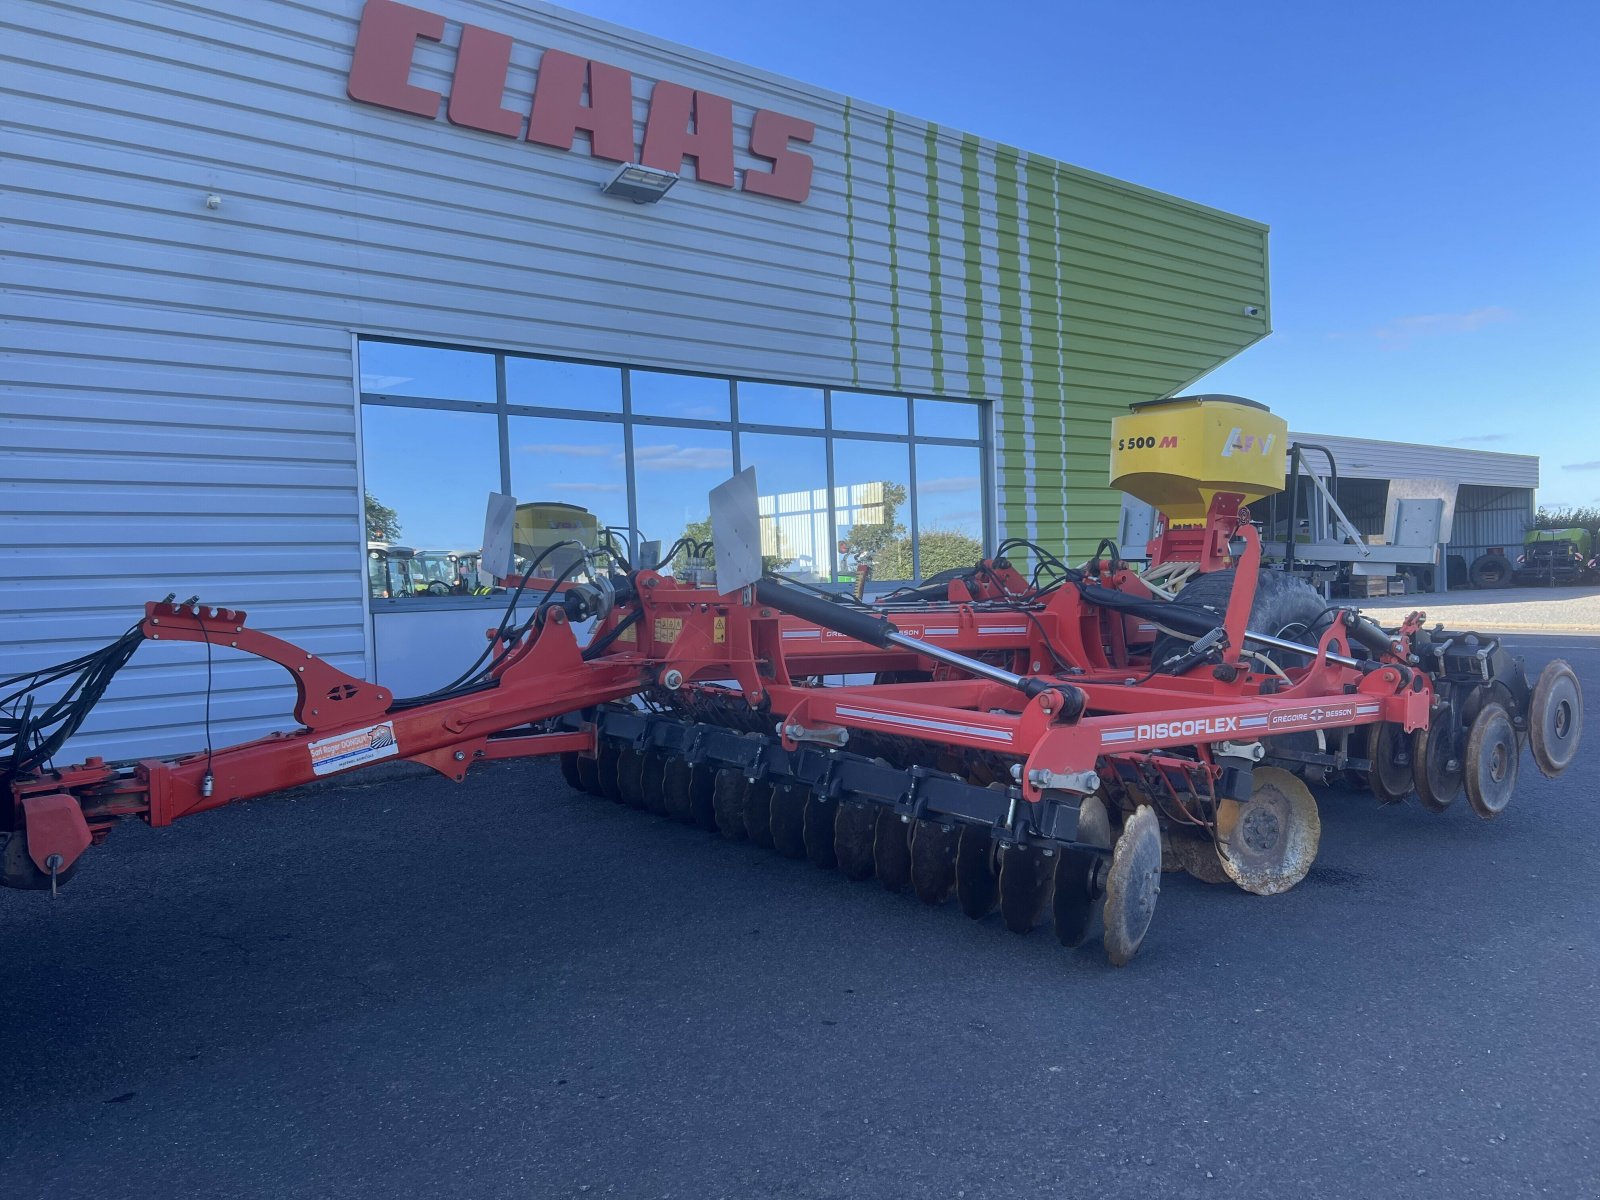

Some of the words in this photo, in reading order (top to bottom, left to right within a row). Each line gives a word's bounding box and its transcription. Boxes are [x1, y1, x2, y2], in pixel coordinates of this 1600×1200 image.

[346, 0, 815, 203] CLAAS
[1118, 438, 1125, 451] S
[1127, 436, 1156, 450] 500
[1158, 436, 1178, 448] M
[1272, 713, 1308, 724] GRÉGOIRE
[1325, 708, 1352, 718] BESSON
[1137, 716, 1237, 742] DISCOFLEX
